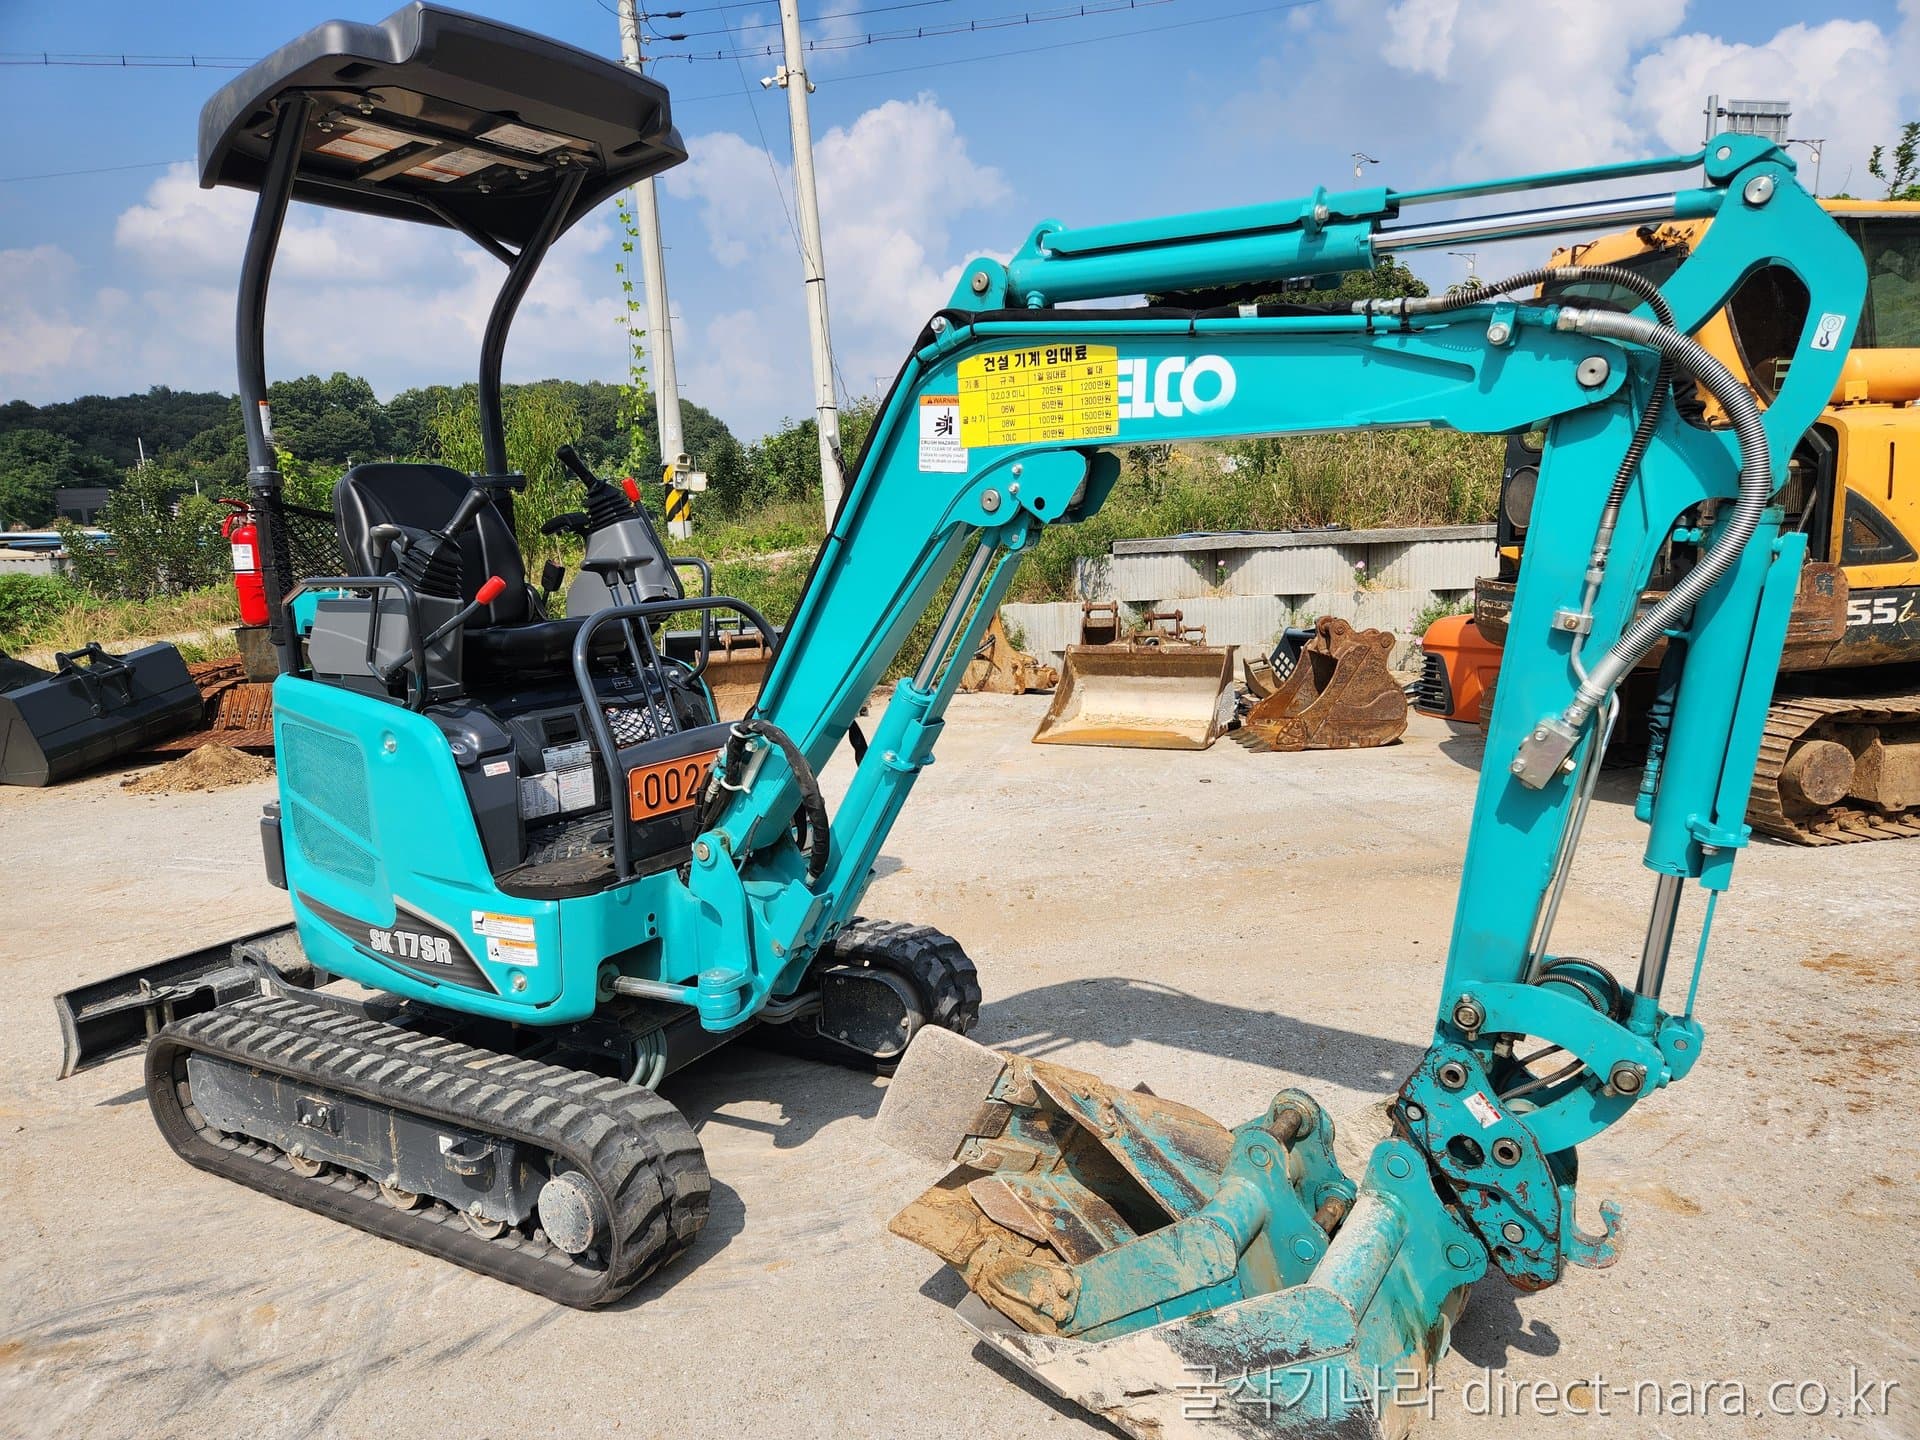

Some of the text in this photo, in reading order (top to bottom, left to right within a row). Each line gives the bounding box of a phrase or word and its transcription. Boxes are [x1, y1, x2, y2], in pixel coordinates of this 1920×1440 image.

[984, 345, 1087, 372] 건설 기계 임대료
[1080, 379, 1111, 391] 1200만원
[933, 397, 960, 405] WARNIN
[1081, 394, 1111, 405] 1300만원
[1039, 414, 1064, 425] 100만원
[1081, 424, 1112, 435] 1300만원
